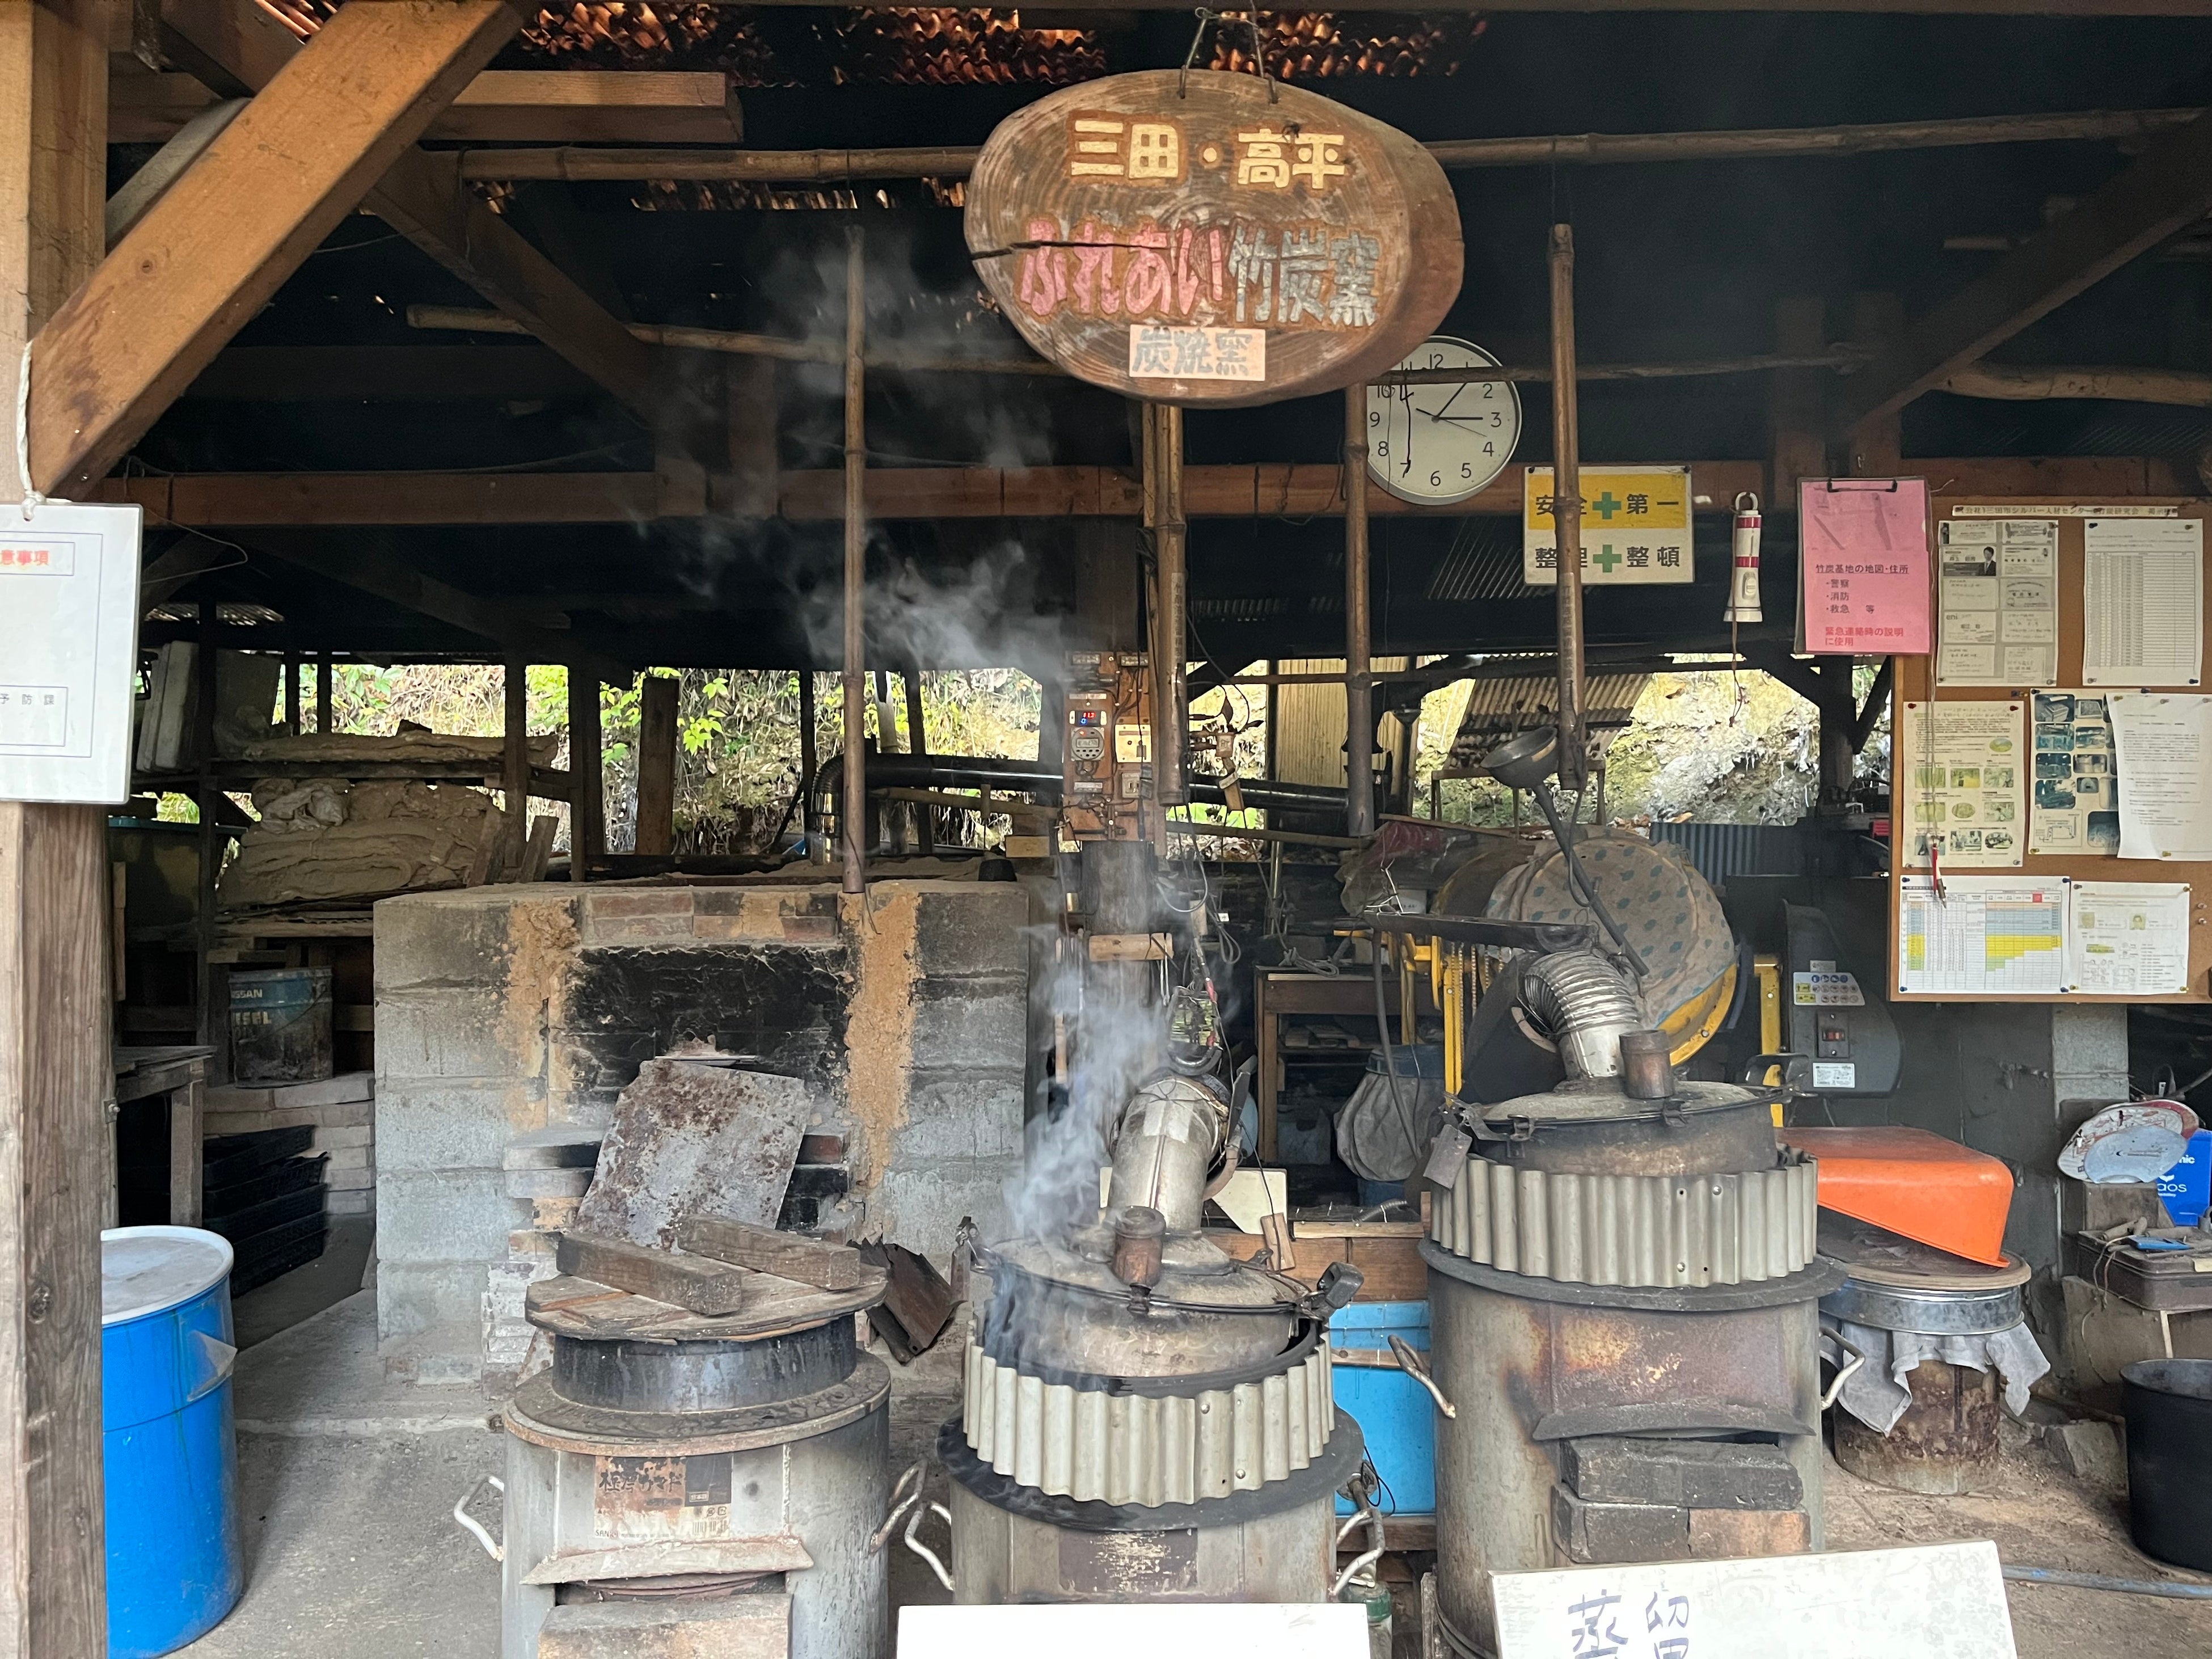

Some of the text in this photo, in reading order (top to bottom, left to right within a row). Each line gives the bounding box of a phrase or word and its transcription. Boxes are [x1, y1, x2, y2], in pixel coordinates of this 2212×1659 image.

[1071, 119, 1345, 189] 三田・高平
[1429, 354, 1444, 369] 12
[1482, 383, 1493, 399] 2
[1369, 412, 1381, 427] 9
[1490, 412, 1502, 428] 3
[1378, 441, 1389, 457] 8
[1482, 441, 1495, 457] 4
[1430, 470, 1441, 486] 6
[1460, 462, 1472, 478] 5
[1626, 493, 1679, 515] 第一
[1626, 546, 1680, 568] 整頓
[1825, 637, 1854, 647] に使用
